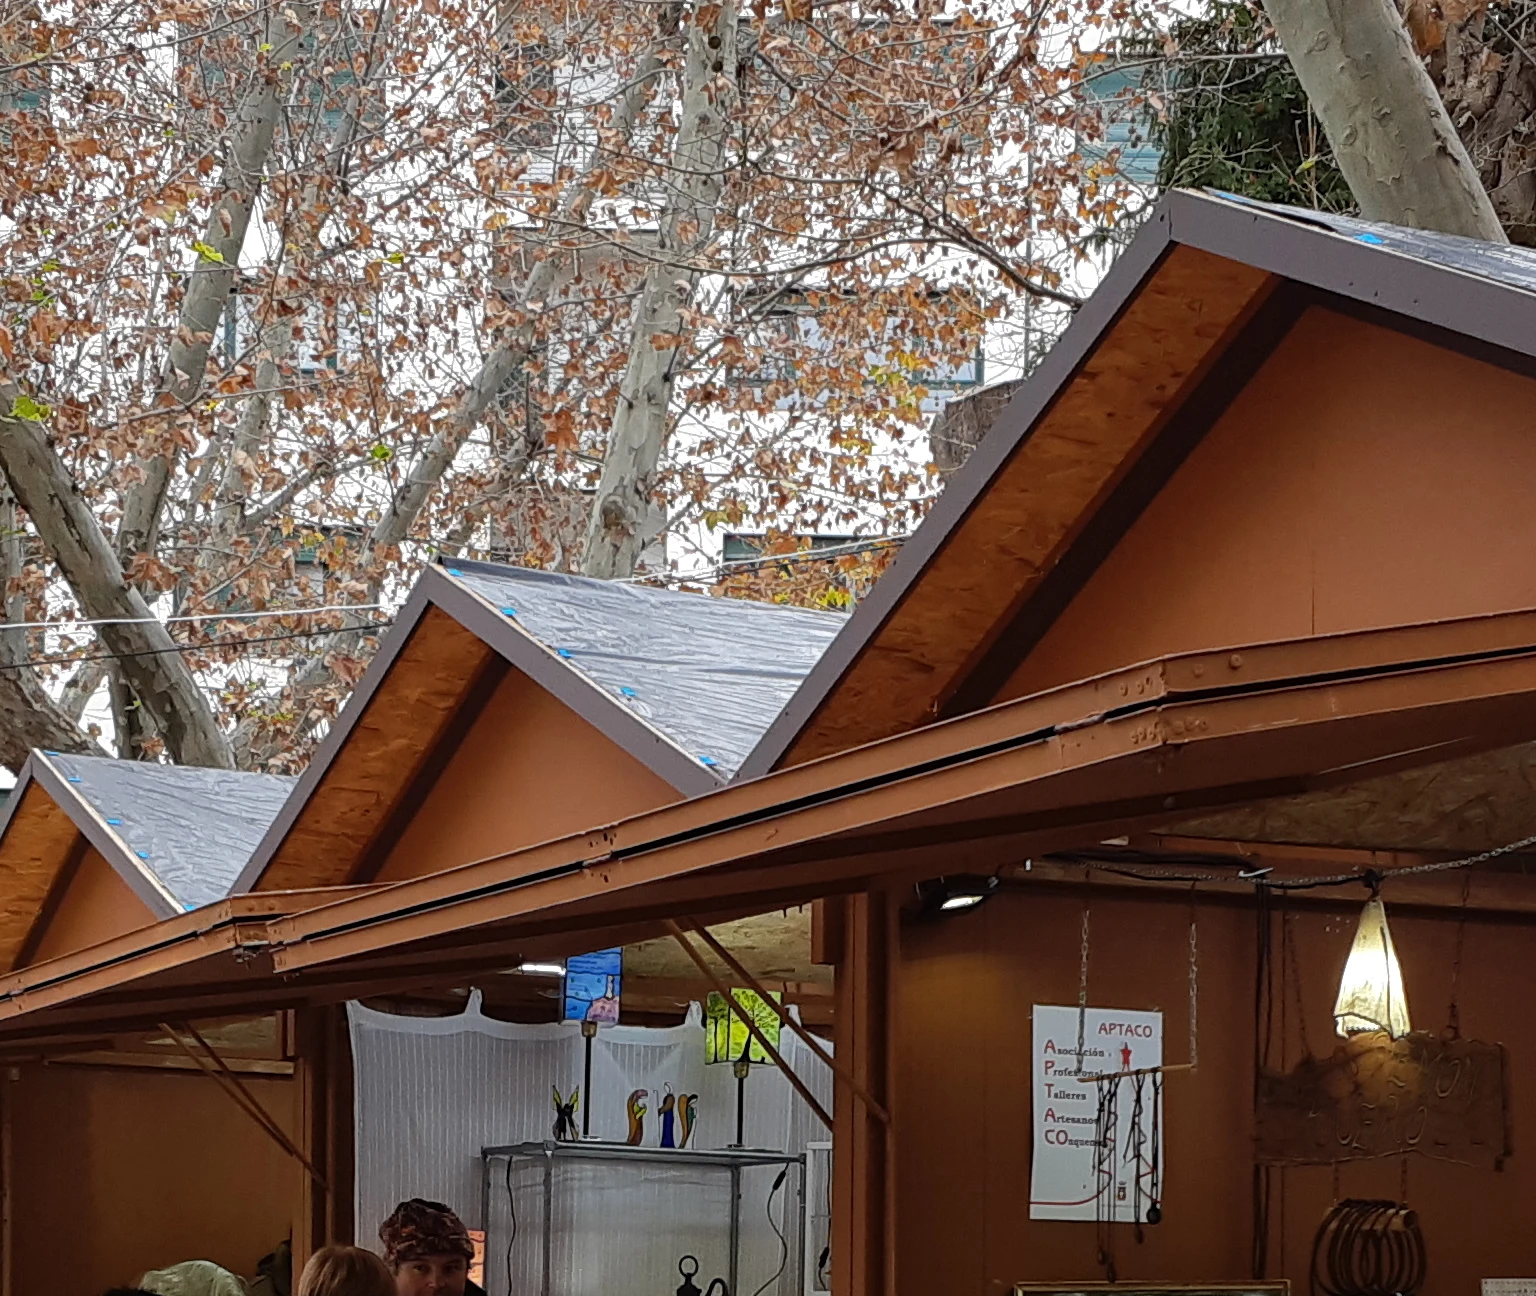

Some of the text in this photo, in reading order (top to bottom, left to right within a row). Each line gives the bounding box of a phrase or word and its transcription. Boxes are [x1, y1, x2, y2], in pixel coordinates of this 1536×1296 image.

[1098, 1022, 1153, 1038] APTACO
[1044, 1039, 1105, 1057] Asocición
[1044, 1083, 1087, 1100] Talleres
